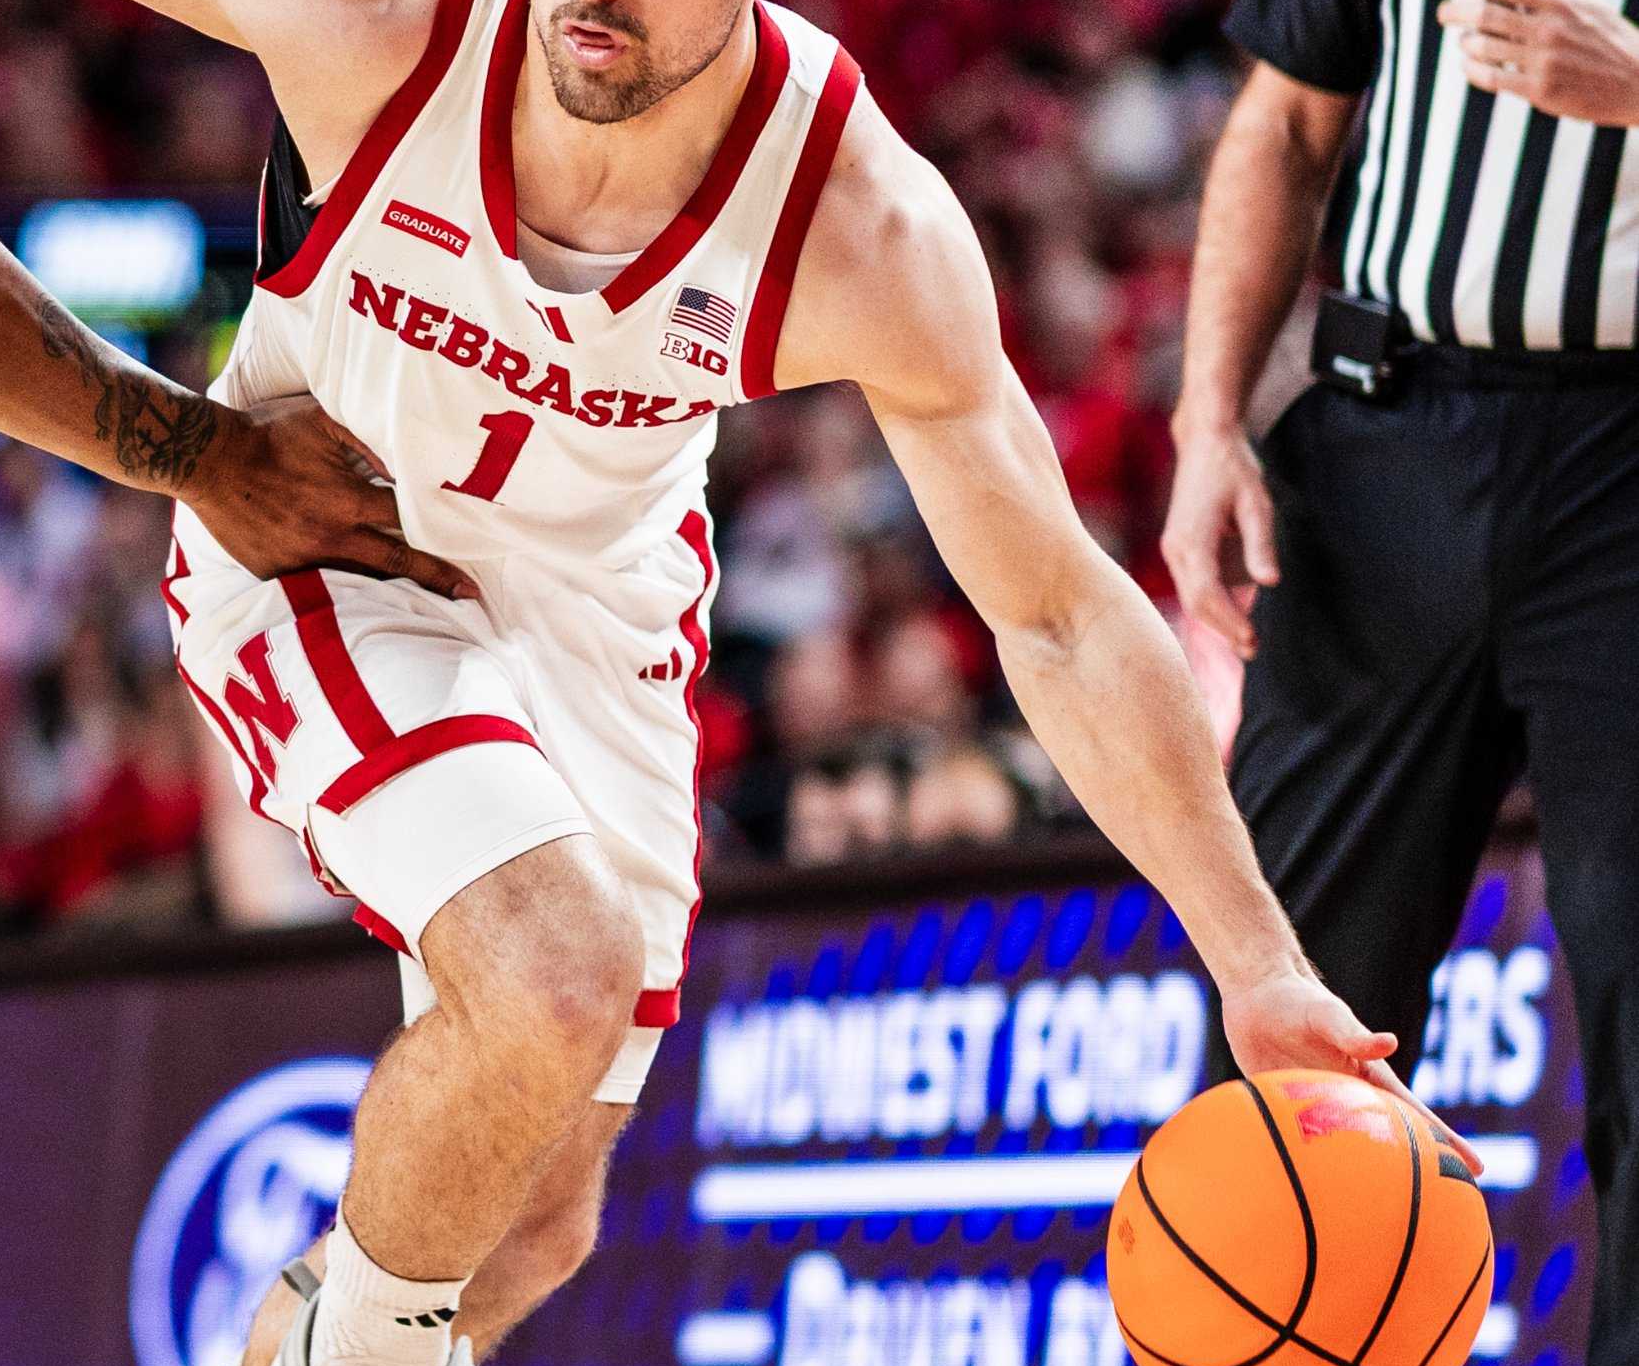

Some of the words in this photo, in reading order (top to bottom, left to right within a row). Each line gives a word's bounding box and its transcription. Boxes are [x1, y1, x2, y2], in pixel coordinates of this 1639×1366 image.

[388, 210, 466, 251] GRADUATE
[440, 409, 535, 503] 1
[692, 985, 1008, 1149] MIDWEST
[1000, 971, 1206, 1131] FORD
